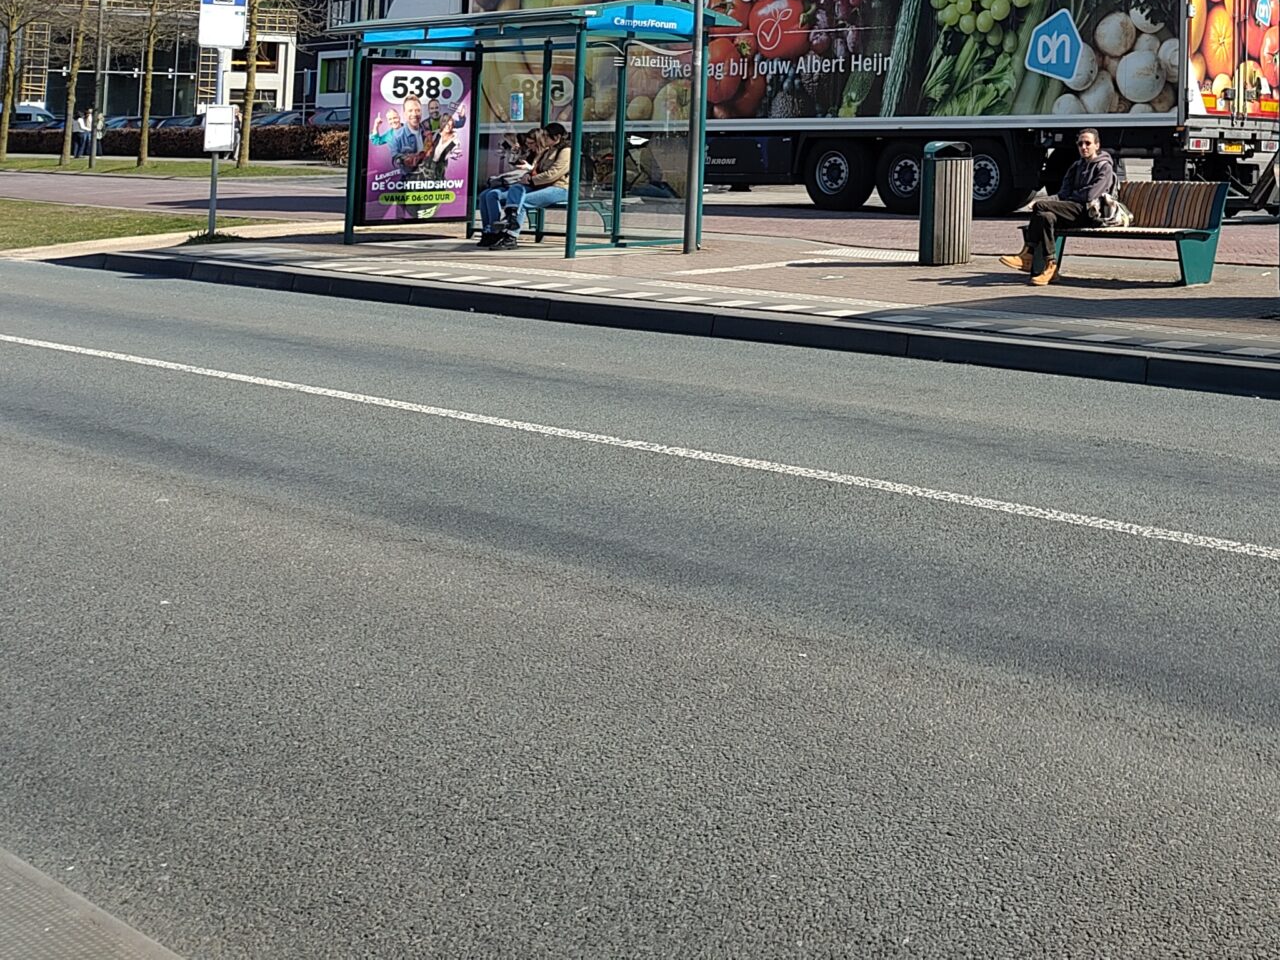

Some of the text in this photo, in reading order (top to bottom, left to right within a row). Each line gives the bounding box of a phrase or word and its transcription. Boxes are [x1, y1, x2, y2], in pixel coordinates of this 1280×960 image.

[613, 16, 678, 29] Campus/Forum
[706, 61, 725, 80] ag
[730, 58, 748, 79] bij
[751, 56, 794, 79] jouw
[796, 54, 844, 75] Albert
[851, 52, 893, 76] Heijn
[391, 76, 441, 99] 538
[371, 178, 464, 191] DE OCHTENDSHOW
[383, 193, 450, 203] VANAF 06:00 UUR
